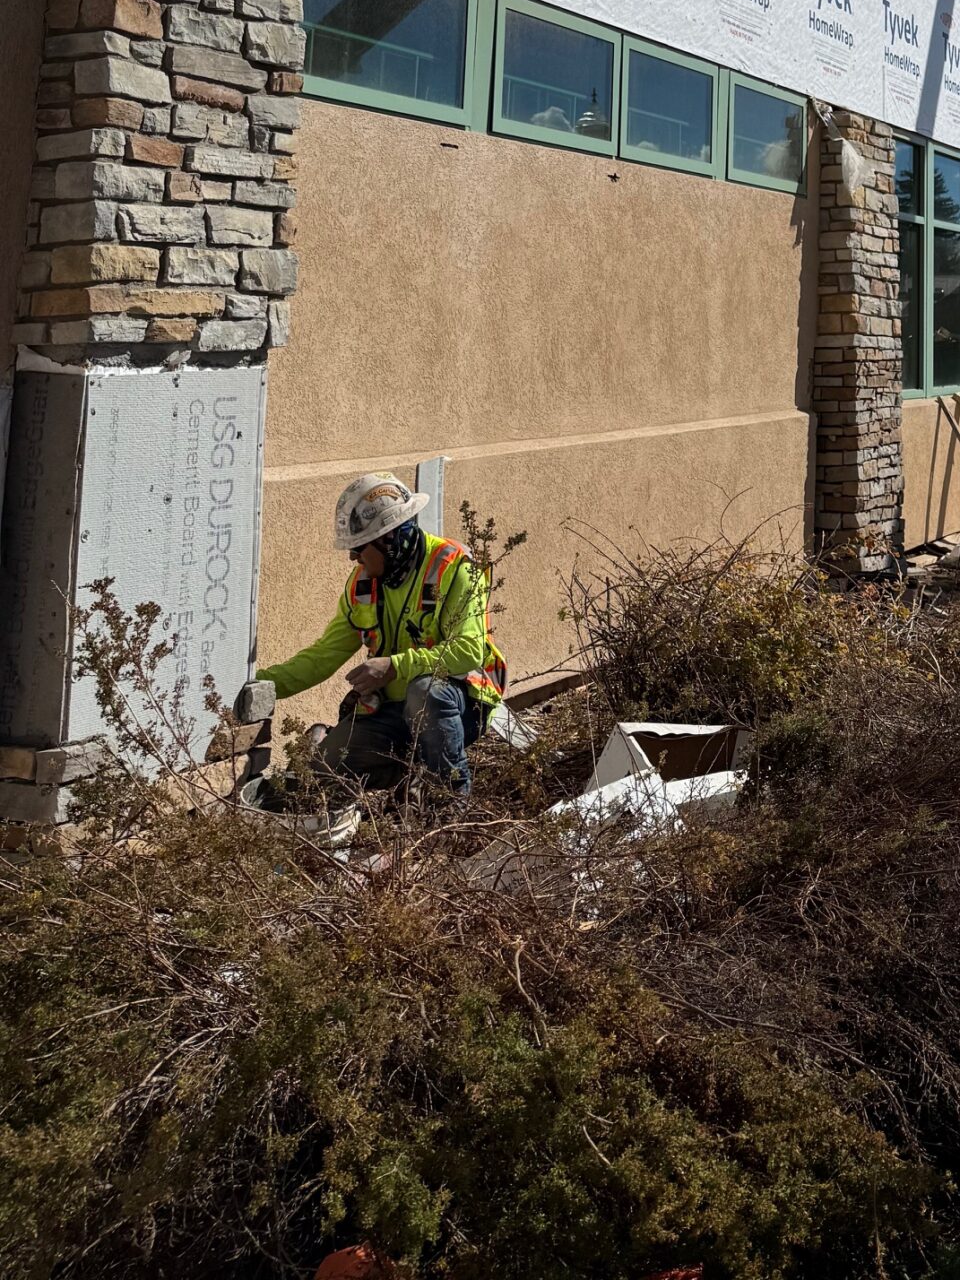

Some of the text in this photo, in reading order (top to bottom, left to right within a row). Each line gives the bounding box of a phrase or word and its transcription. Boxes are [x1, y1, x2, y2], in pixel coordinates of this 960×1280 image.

[809, 9, 854, 51] HomeWrap
[884, 46, 920, 80] HomeWrap
[185, 398, 205, 492] Cement
[211, 396, 238, 469] USG
[181, 496, 200, 567] Board
[201, 478, 234, 634] DUROCK
